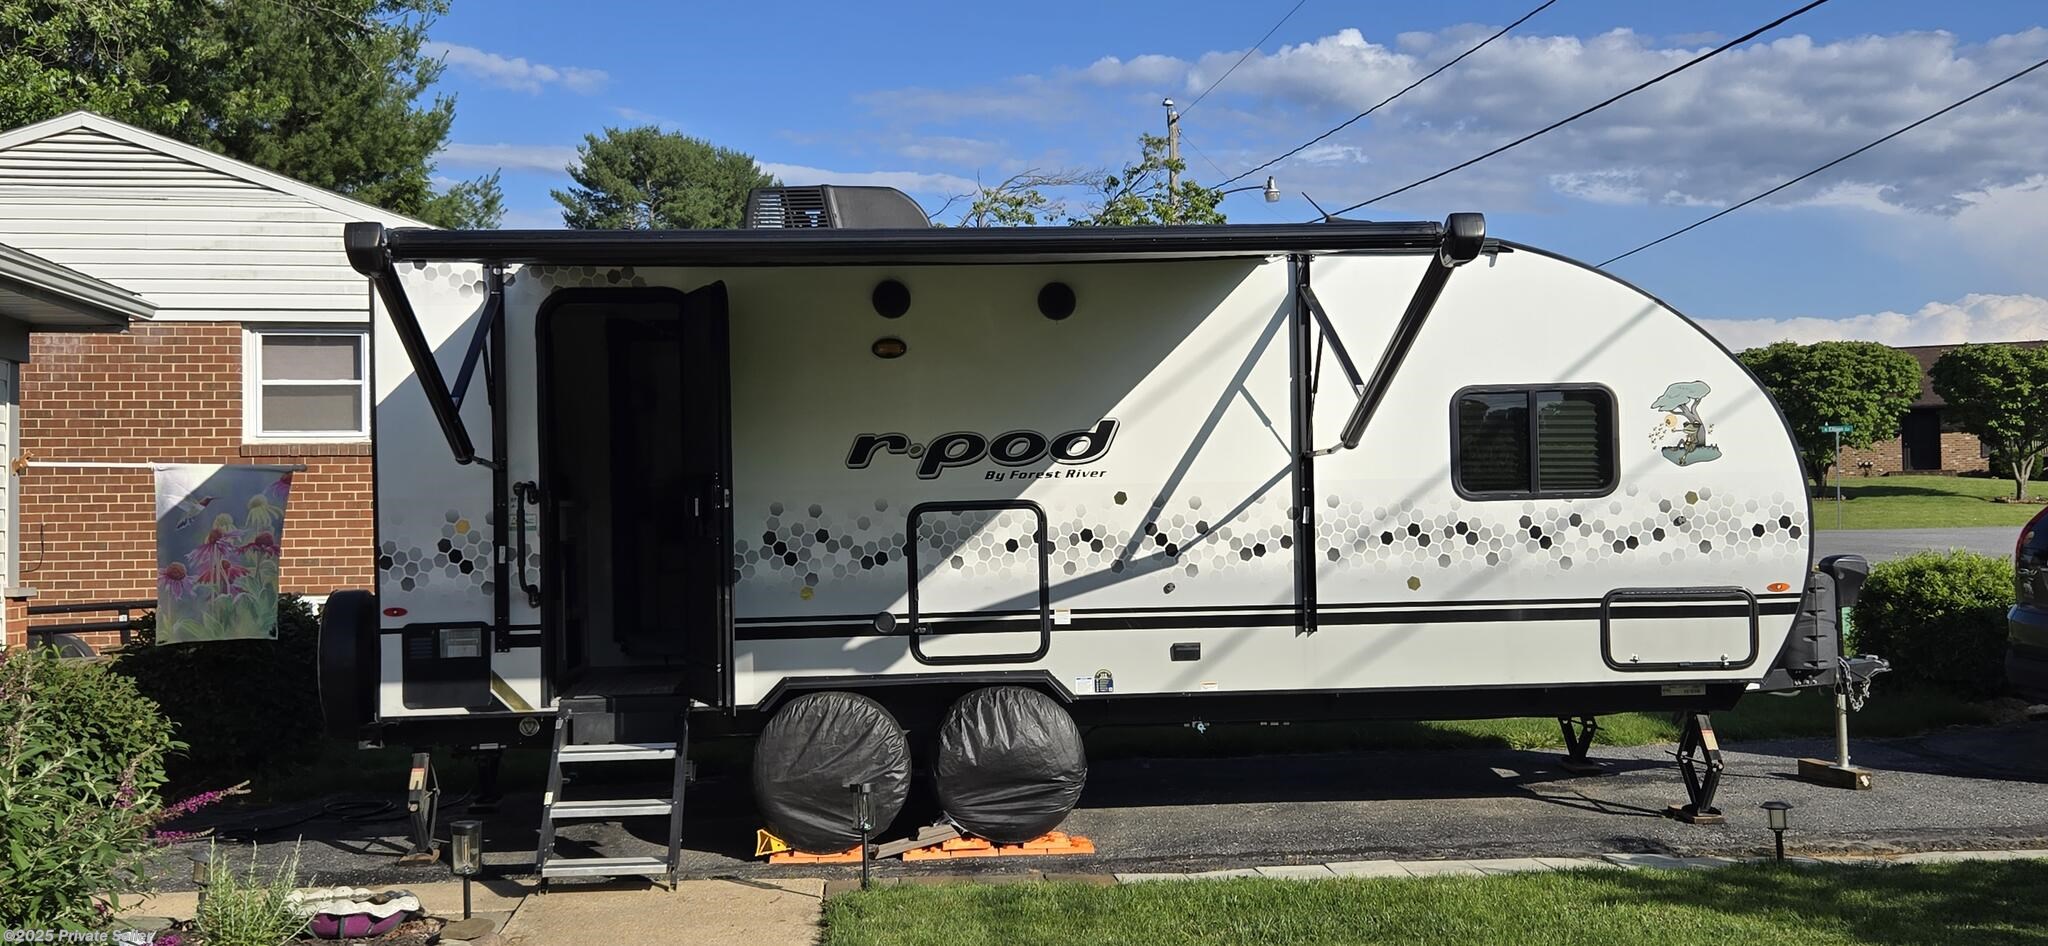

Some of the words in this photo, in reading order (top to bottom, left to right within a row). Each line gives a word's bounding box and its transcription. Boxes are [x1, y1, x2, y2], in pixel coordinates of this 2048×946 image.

[985, 470, 1005, 482] By
[1009, 470, 1061, 480] Forest
[1065, 469, 1107, 479] River
